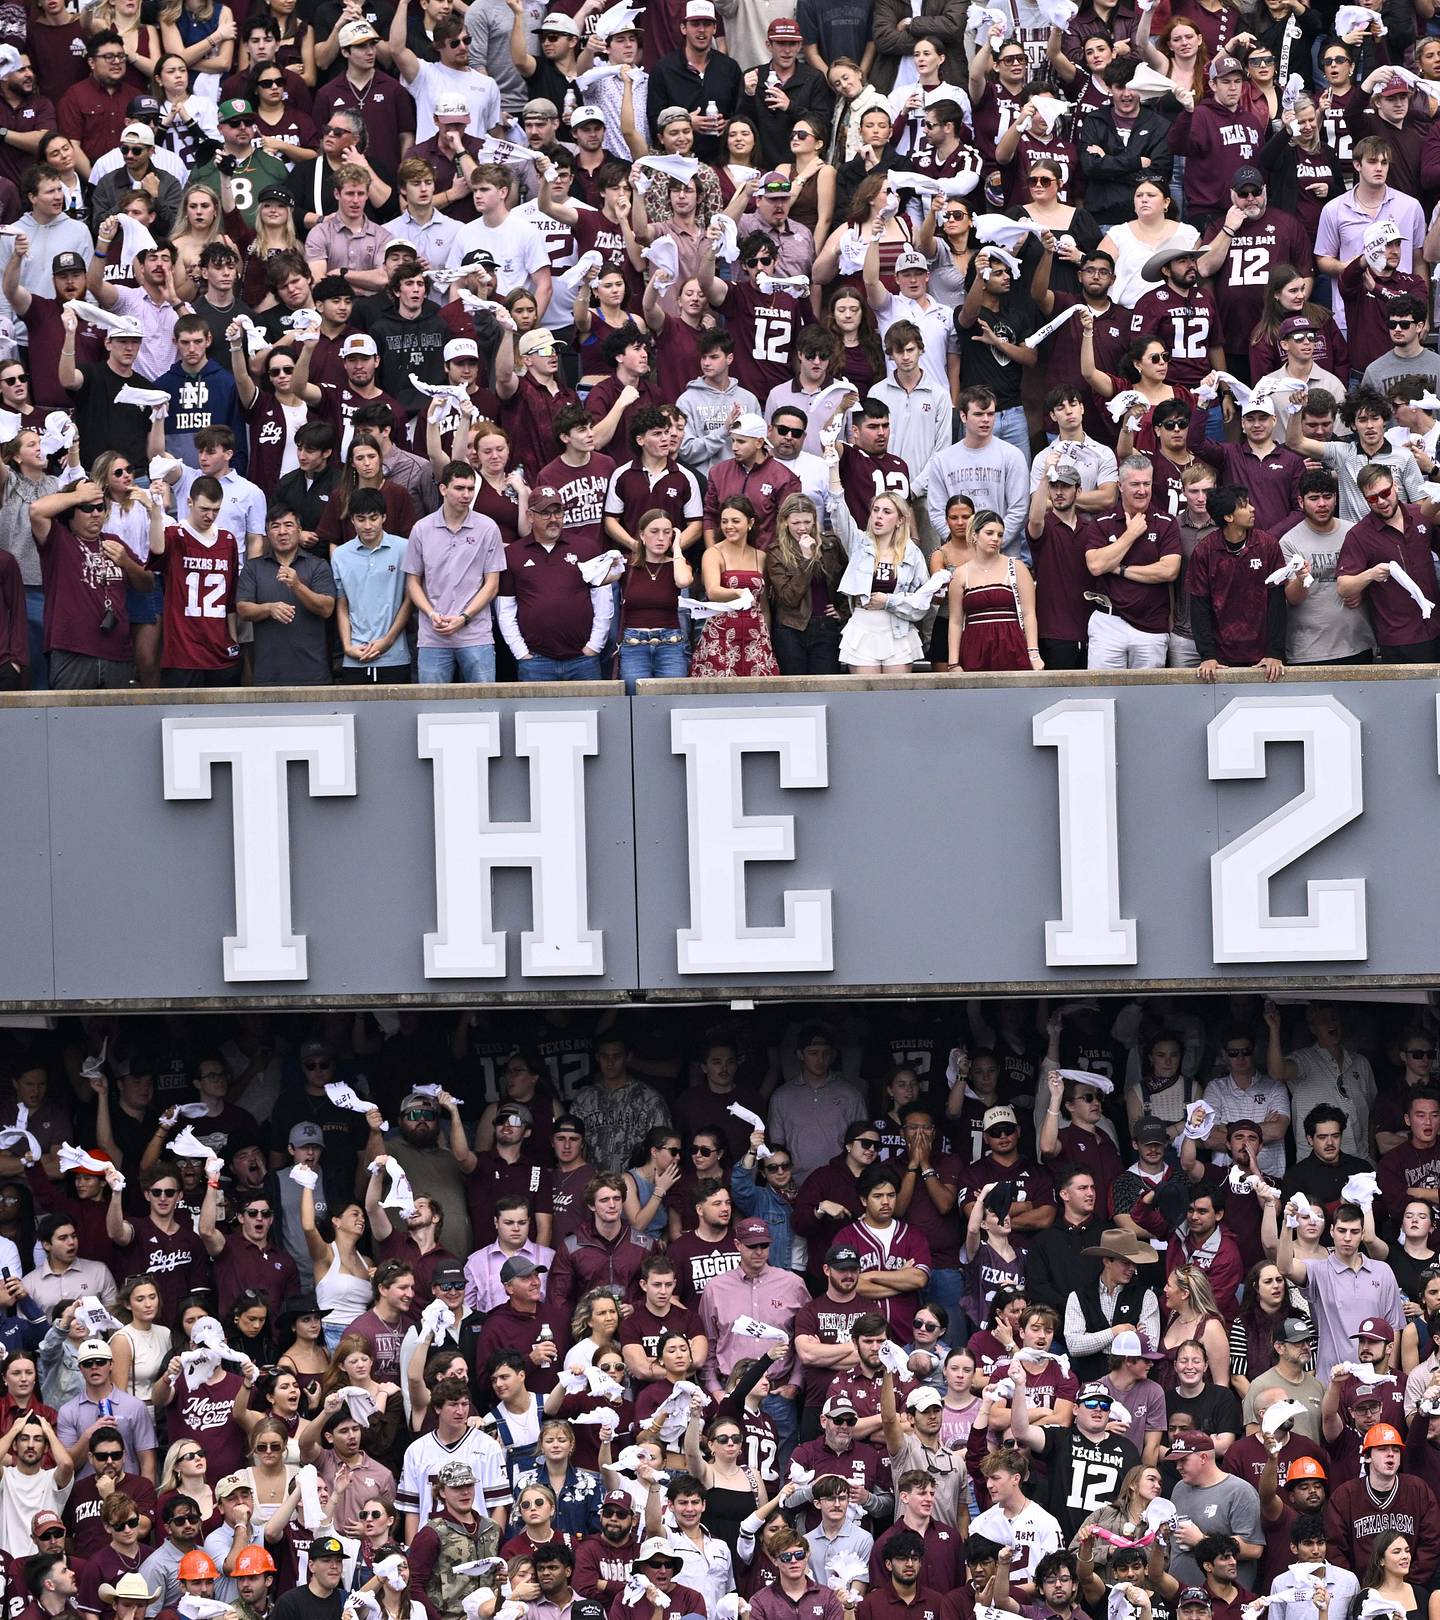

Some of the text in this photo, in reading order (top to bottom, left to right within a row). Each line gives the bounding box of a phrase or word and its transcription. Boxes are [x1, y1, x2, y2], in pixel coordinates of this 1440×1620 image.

[1231, 235, 1277, 248] EXAS A&M
[1228, 248, 1270, 287] 12
[754, 307, 774, 318] TEXAS
[752, 318, 792, 364] 12
[1171, 317, 1209, 359] 12
[176, 413, 212, 431] IRISH
[558, 477, 590, 502] TEXAS
[563, 503, 604, 524] AGGIE
[183, 556, 212, 571] TEXAS
[876, 568, 890, 581] 12
[184, 572, 227, 618] 12
[162, 705, 833, 981] THE
[544, 1053, 590, 1103] 12
[584, 1110, 641, 1130] TEXAS A&M
[881, 1135, 907, 1147] EXAS
[149, 1249, 191, 1273] Aggies
[691, 1257, 741, 1281] AGGIE
[982, 1266, 1011, 1285] TEXAS
[182, 1397, 235, 1417] Maroon
[203, 1412, 232, 1431] Out
[745, 1435, 779, 1481] 12
[1072, 1445, 1124, 1469] TEXAS A&M
[1066, 1458, 1119, 1512] 12
[1015, 1531, 1035, 1542] A&M
[1354, 1514, 1415, 1539] TEXAS A&M
